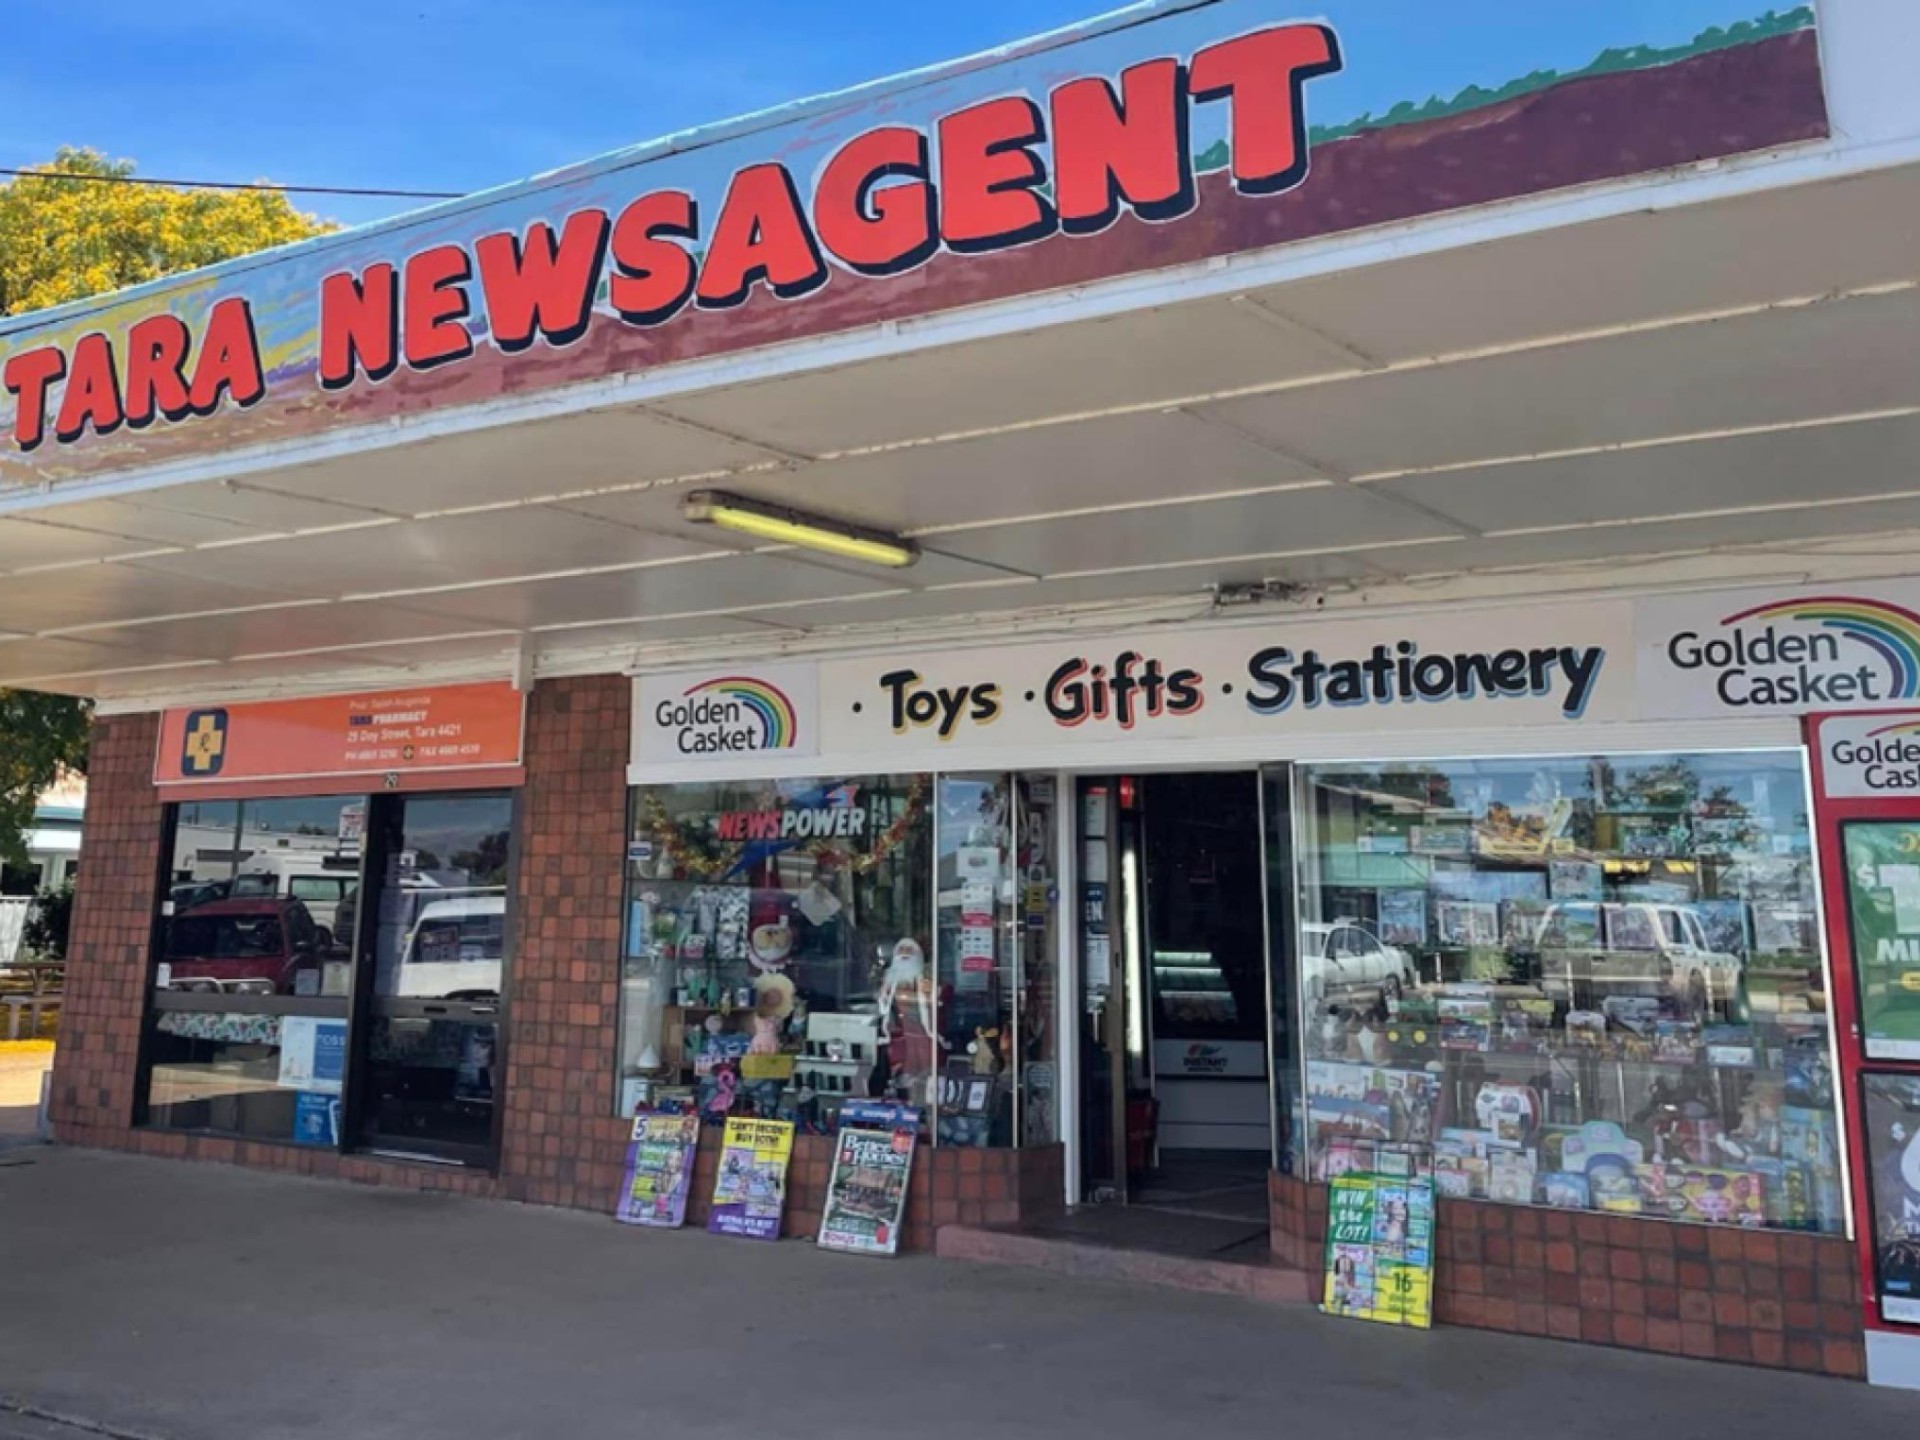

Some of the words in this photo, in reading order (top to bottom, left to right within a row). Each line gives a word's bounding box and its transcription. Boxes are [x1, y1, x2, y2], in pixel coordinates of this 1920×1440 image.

[4, 297, 265, 450] TARA
[318, 22, 1342, 388] NEWSAGENT
[1668, 626, 1838, 669] Golden
[881, 669, 1001, 741] Toys
[1045, 652, 1204, 729] Gifts
[1247, 641, 1605, 719] Stationery
[1717, 665, 1880, 706] Casket
[373, 711, 428, 725] PHARMACY
[656, 697, 740, 727] Golden
[678, 725, 758, 753] Casket
[1864, 764, 1920, 789] Cas
[717, 806, 865, 840] NEWSPOWER
[1336, 1190, 1368, 1205] WIN
